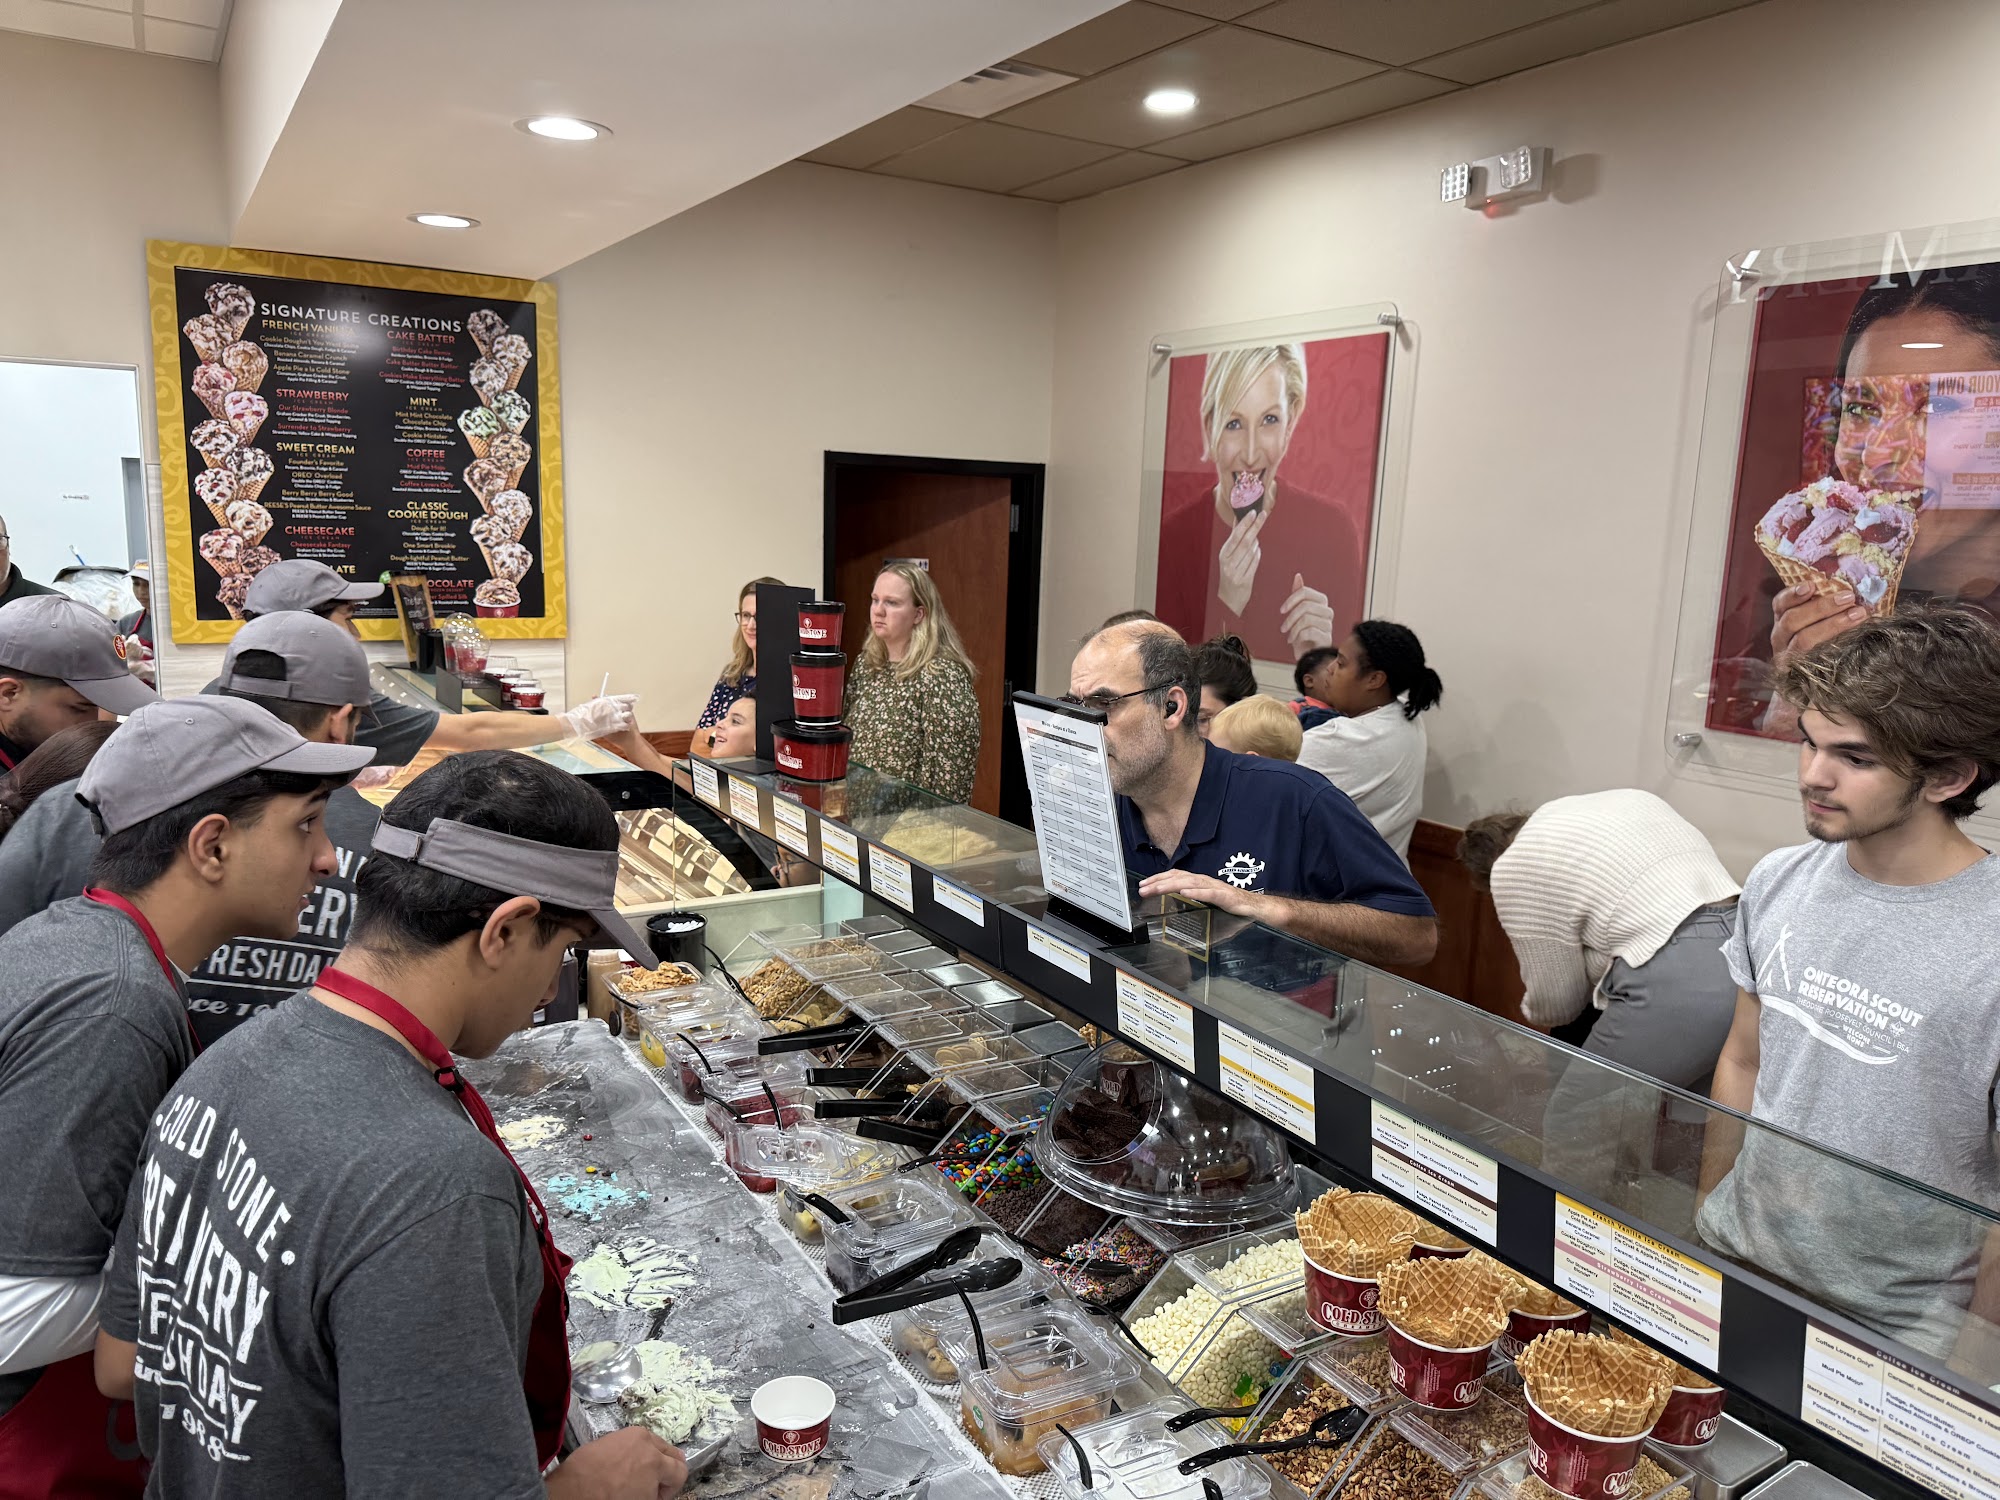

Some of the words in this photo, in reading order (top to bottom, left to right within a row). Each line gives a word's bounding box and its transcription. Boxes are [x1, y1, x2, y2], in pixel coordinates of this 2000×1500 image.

[261, 303, 360, 324] SIGNATURE
[368, 313, 462, 332] CREATIONS
[262, 319, 309, 332] FRENCH
[310, 323, 356, 337] VANILLA
[387, 330, 416, 341] CAKE
[417, 333, 456, 344] BATTER
[276, 388, 349, 402] STRAWBERRY
[409, 397, 438, 407] MINT
[276, 442, 315, 453] SWEET
[316, 444, 355, 454] CREAM
[406, 448, 446, 459] COFFEE
[388, 510, 429, 519] COOKIE
[430, 511, 469, 520] DOUGH
[407, 501, 449, 511] CLASSIC
[285, 526, 355, 536] CHEESECAKE
[427, 580, 475, 588] OCOLATE
[193, 944, 287, 981] RESH
[1797, 980, 1889, 1030] RESERVATION
[1803, 966, 1869, 1004] ONTEORA
[1869, 993, 1924, 1028] SCOUT
[1796, 996, 1825, 1014] THEODORE
[1825, 1008, 1863, 1029] ROOSEVELT
[1862, 1025, 1892, 1045] COUNCIL
[1896, 1041, 1910, 1054] BSA
[1842, 1024, 1872, 1045] WELCOME
[1846, 1033, 1865, 1049] HOME
[159, 1094, 217, 1159] COLD
[216, 1127, 292, 1264] STONE
[1592, 1211, 1615, 1227] French
[1617, 1223, 1642, 1240] Vanilla
[1644, 1238, 1655, 1246] Ice
[1657, 1244, 1680, 1258] Cream
[1596, 1262, 1634, 1286] Strawberry
[1636, 1281, 1647, 1292] Ice
[1649, 1287, 1672, 1305] Cream
[1321, 1302, 1361, 1325] COLD
[1815, 1337, 1835, 1350] Coffee
[1835, 1346, 1856, 1360] Lovers
[1821, 1362, 1835, 1373] Mud
[1835, 1369, 1845, 1379] Pie
[1876, 1350, 1907, 1369] Coffee
[1910, 1366, 1926, 1378] Ice
[1929, 1375, 1960, 1395] Cream
[1807, 1383, 1823, 1396] Berry
[1823, 1392, 1840, 1405] Berry
[1840, 1400, 1857, 1413] Berry
[1886, 1391, 1908, 1407] Fudge,
[1909, 1403, 1932, 1419] Peanut
[1887, 1372, 1916, 1391] Caramel,
[1917, 1387, 1945, 1404] Roasted
[1945, 1401, 1977, 1420] Almonds
[1885, 1398, 1912, 1415] Roasted
[1912, 1411, 1942, 1430] Almonds
[1858, 1398, 1885, 1415] Sweet
[1888, 1413, 1917, 1432] Cream
[1921, 1430, 1936, 1441] Ice
[1940, 1440, 1971, 1460] Cream
[763, 1438, 787, 1456] COLD
[786, 1437, 822, 1456] STONE
[1882, 1437, 1904, 1454] Fudge,
[1905, 1450, 1934, 1470] Caramel,
[1935, 1465, 1960, 1483] Pecans
[1883, 1423, 1923, 1449] Raspberries,
[1923, 1444, 1965, 1470] Strawberries
[1881, 1450, 1903, 1466] Fudge,
[1904, 1463, 1937, 1484] Chocolate
[1938, 1480, 1958, 1496] Chips
